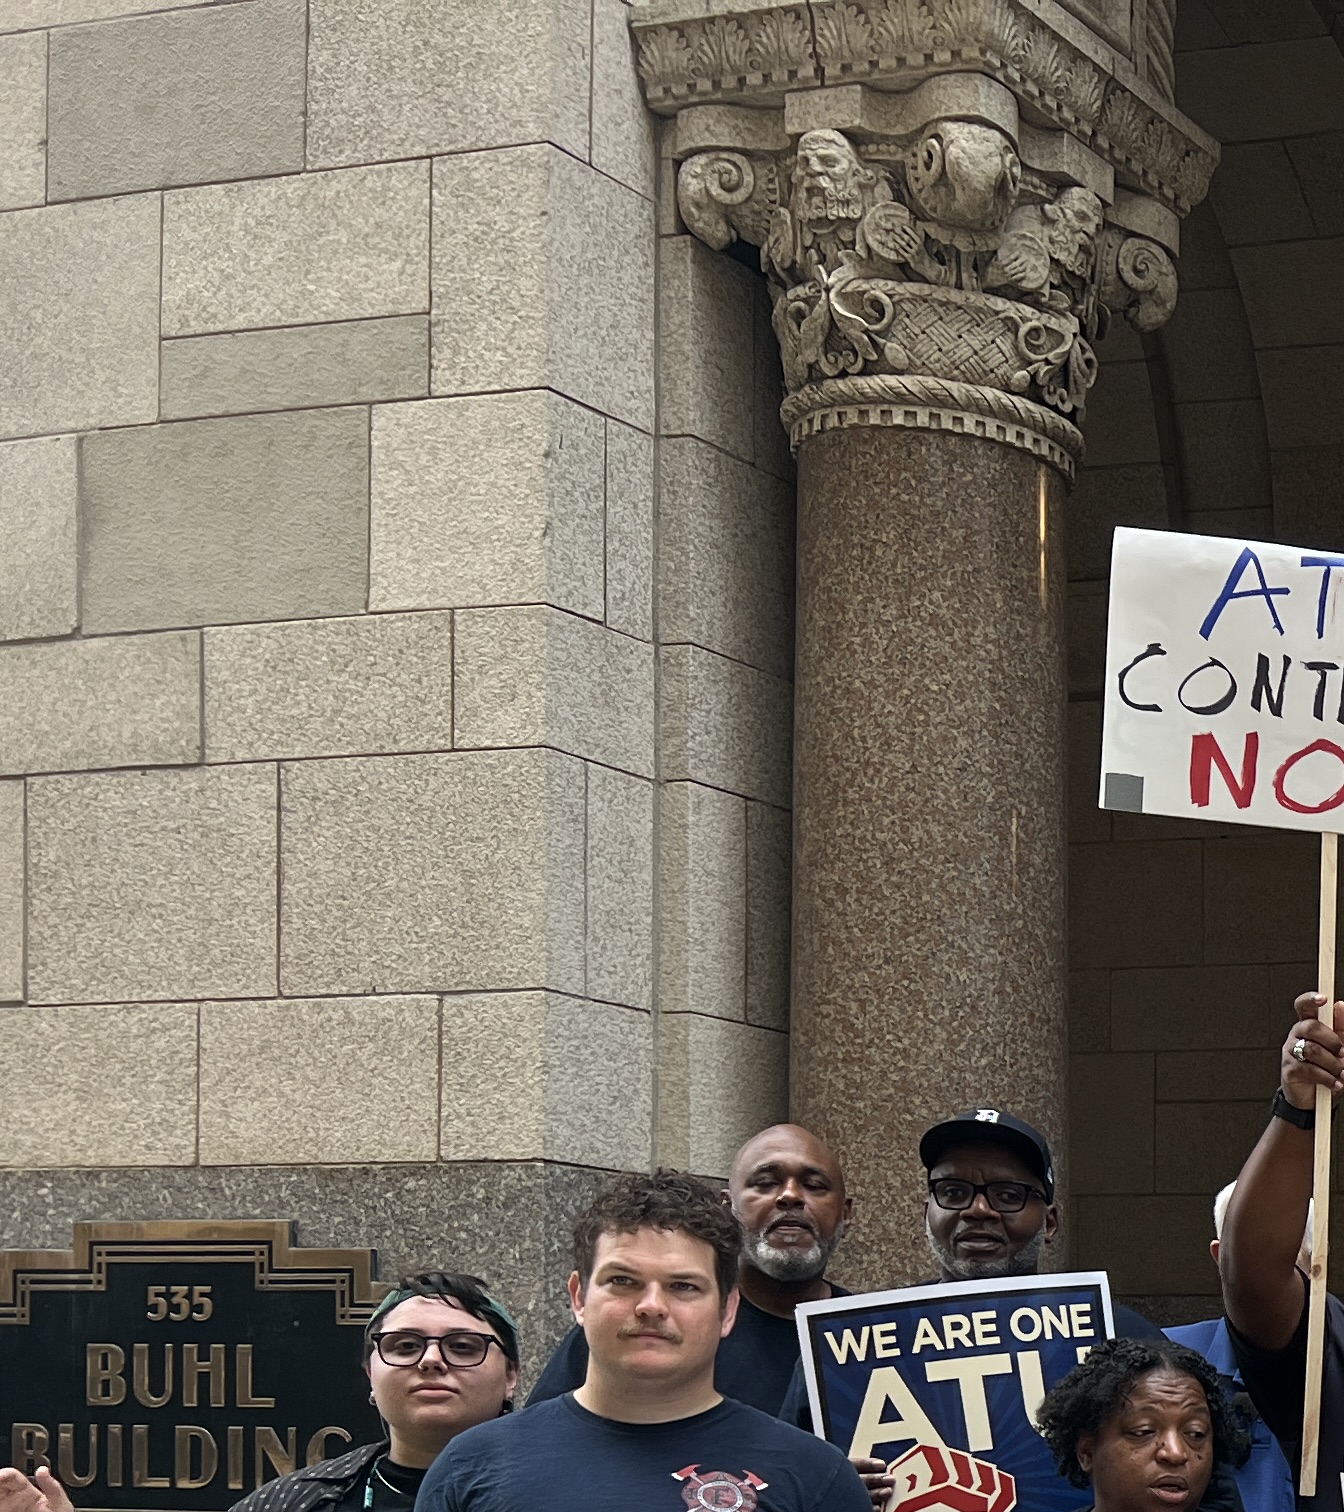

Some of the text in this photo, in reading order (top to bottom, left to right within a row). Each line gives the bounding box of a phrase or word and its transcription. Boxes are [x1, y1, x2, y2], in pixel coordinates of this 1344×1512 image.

[147, 1286, 213, 1321] 535
[824, 1303, 1095, 1366] WE ARE ONE
[86, 1343, 276, 1408] BUHL
